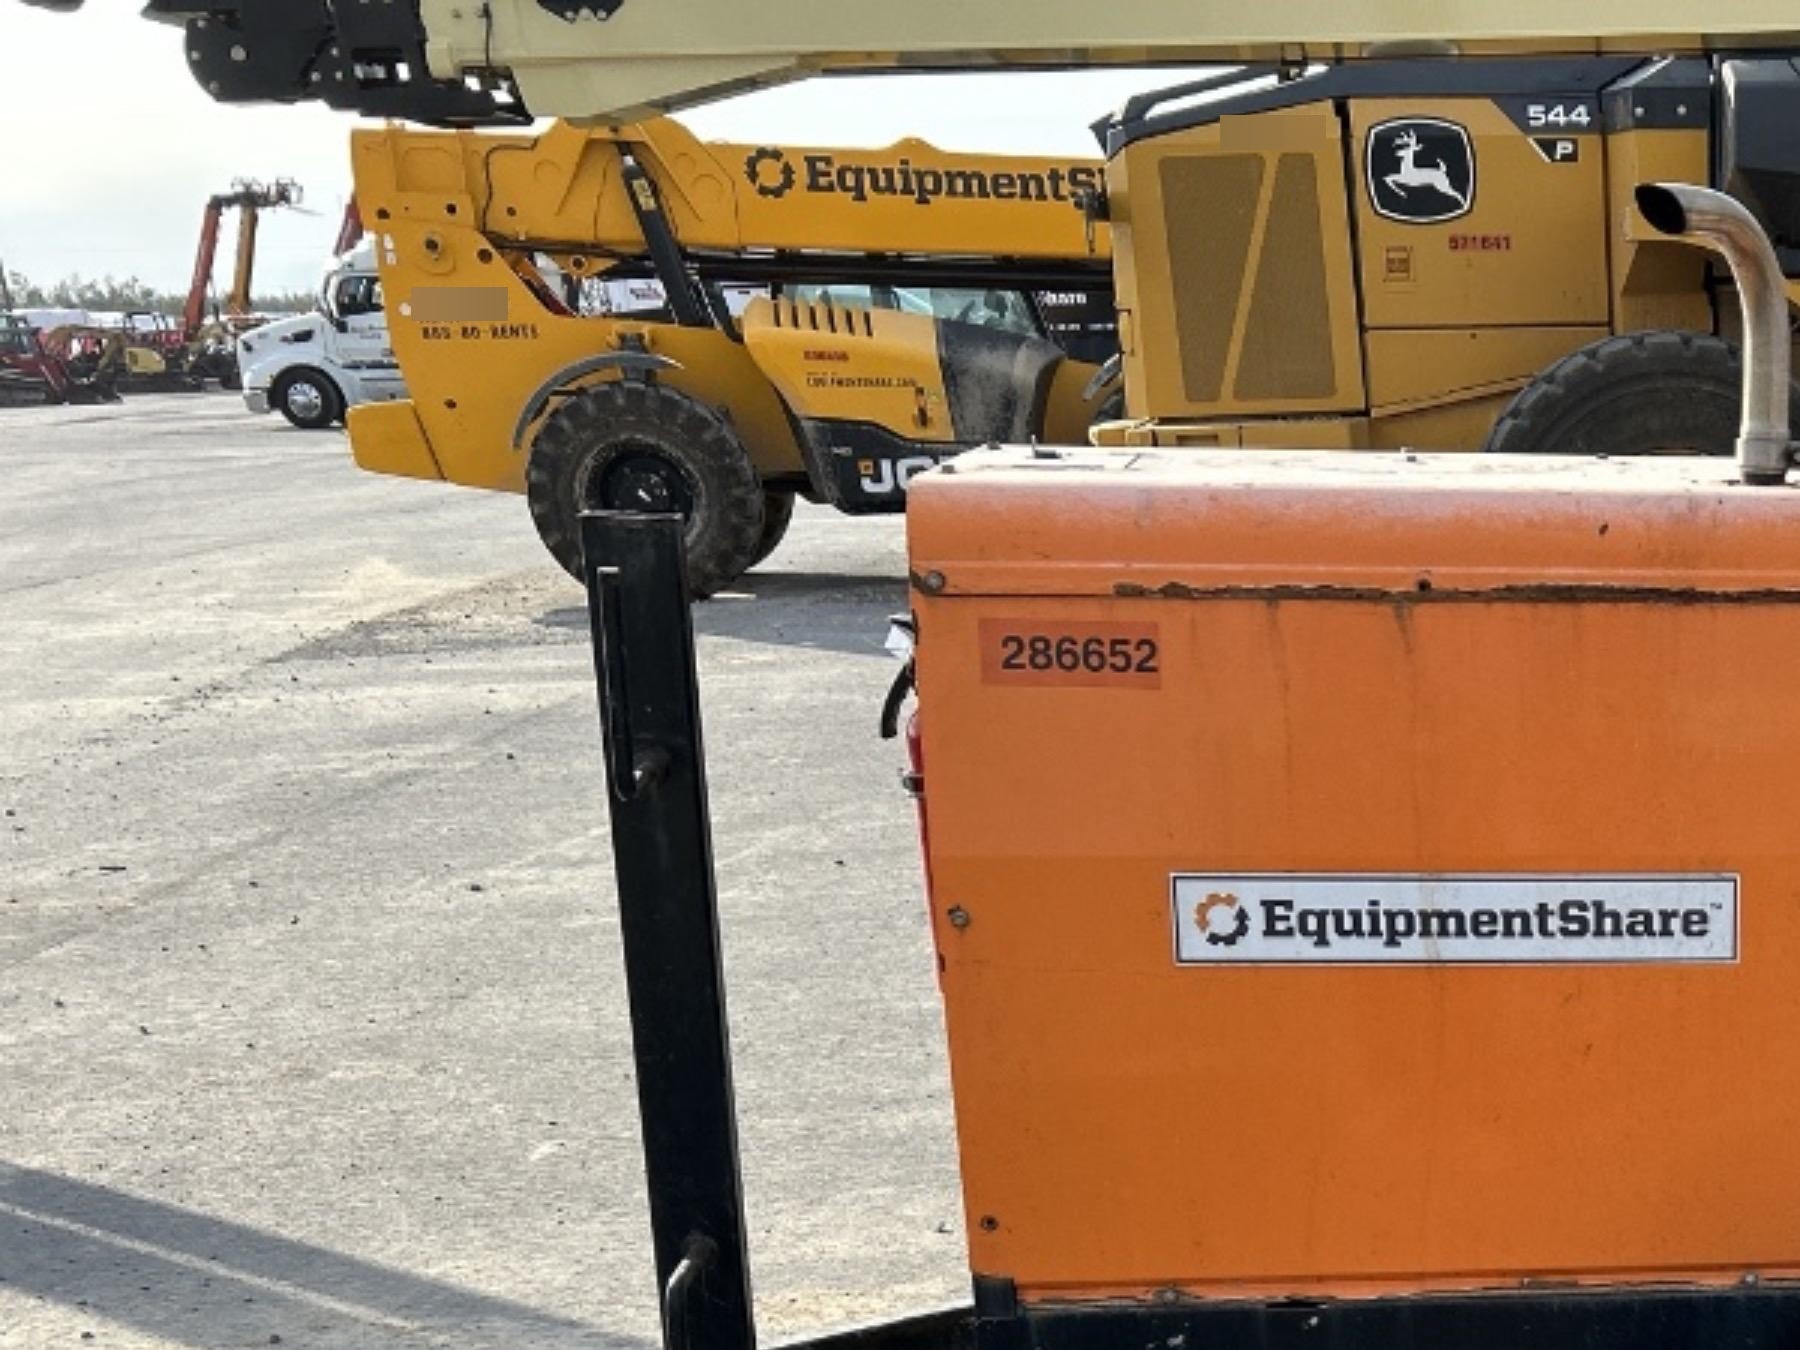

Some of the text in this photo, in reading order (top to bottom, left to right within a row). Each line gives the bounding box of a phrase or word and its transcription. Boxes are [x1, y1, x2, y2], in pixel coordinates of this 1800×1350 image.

[1527, 104, 1591, 127] 544
[1555, 141, 1574, 160] P
[804, 155, 1105, 205] EquipmentS
[860, 456, 936, 494] JC
[1001, 634, 1159, 673] 286652
